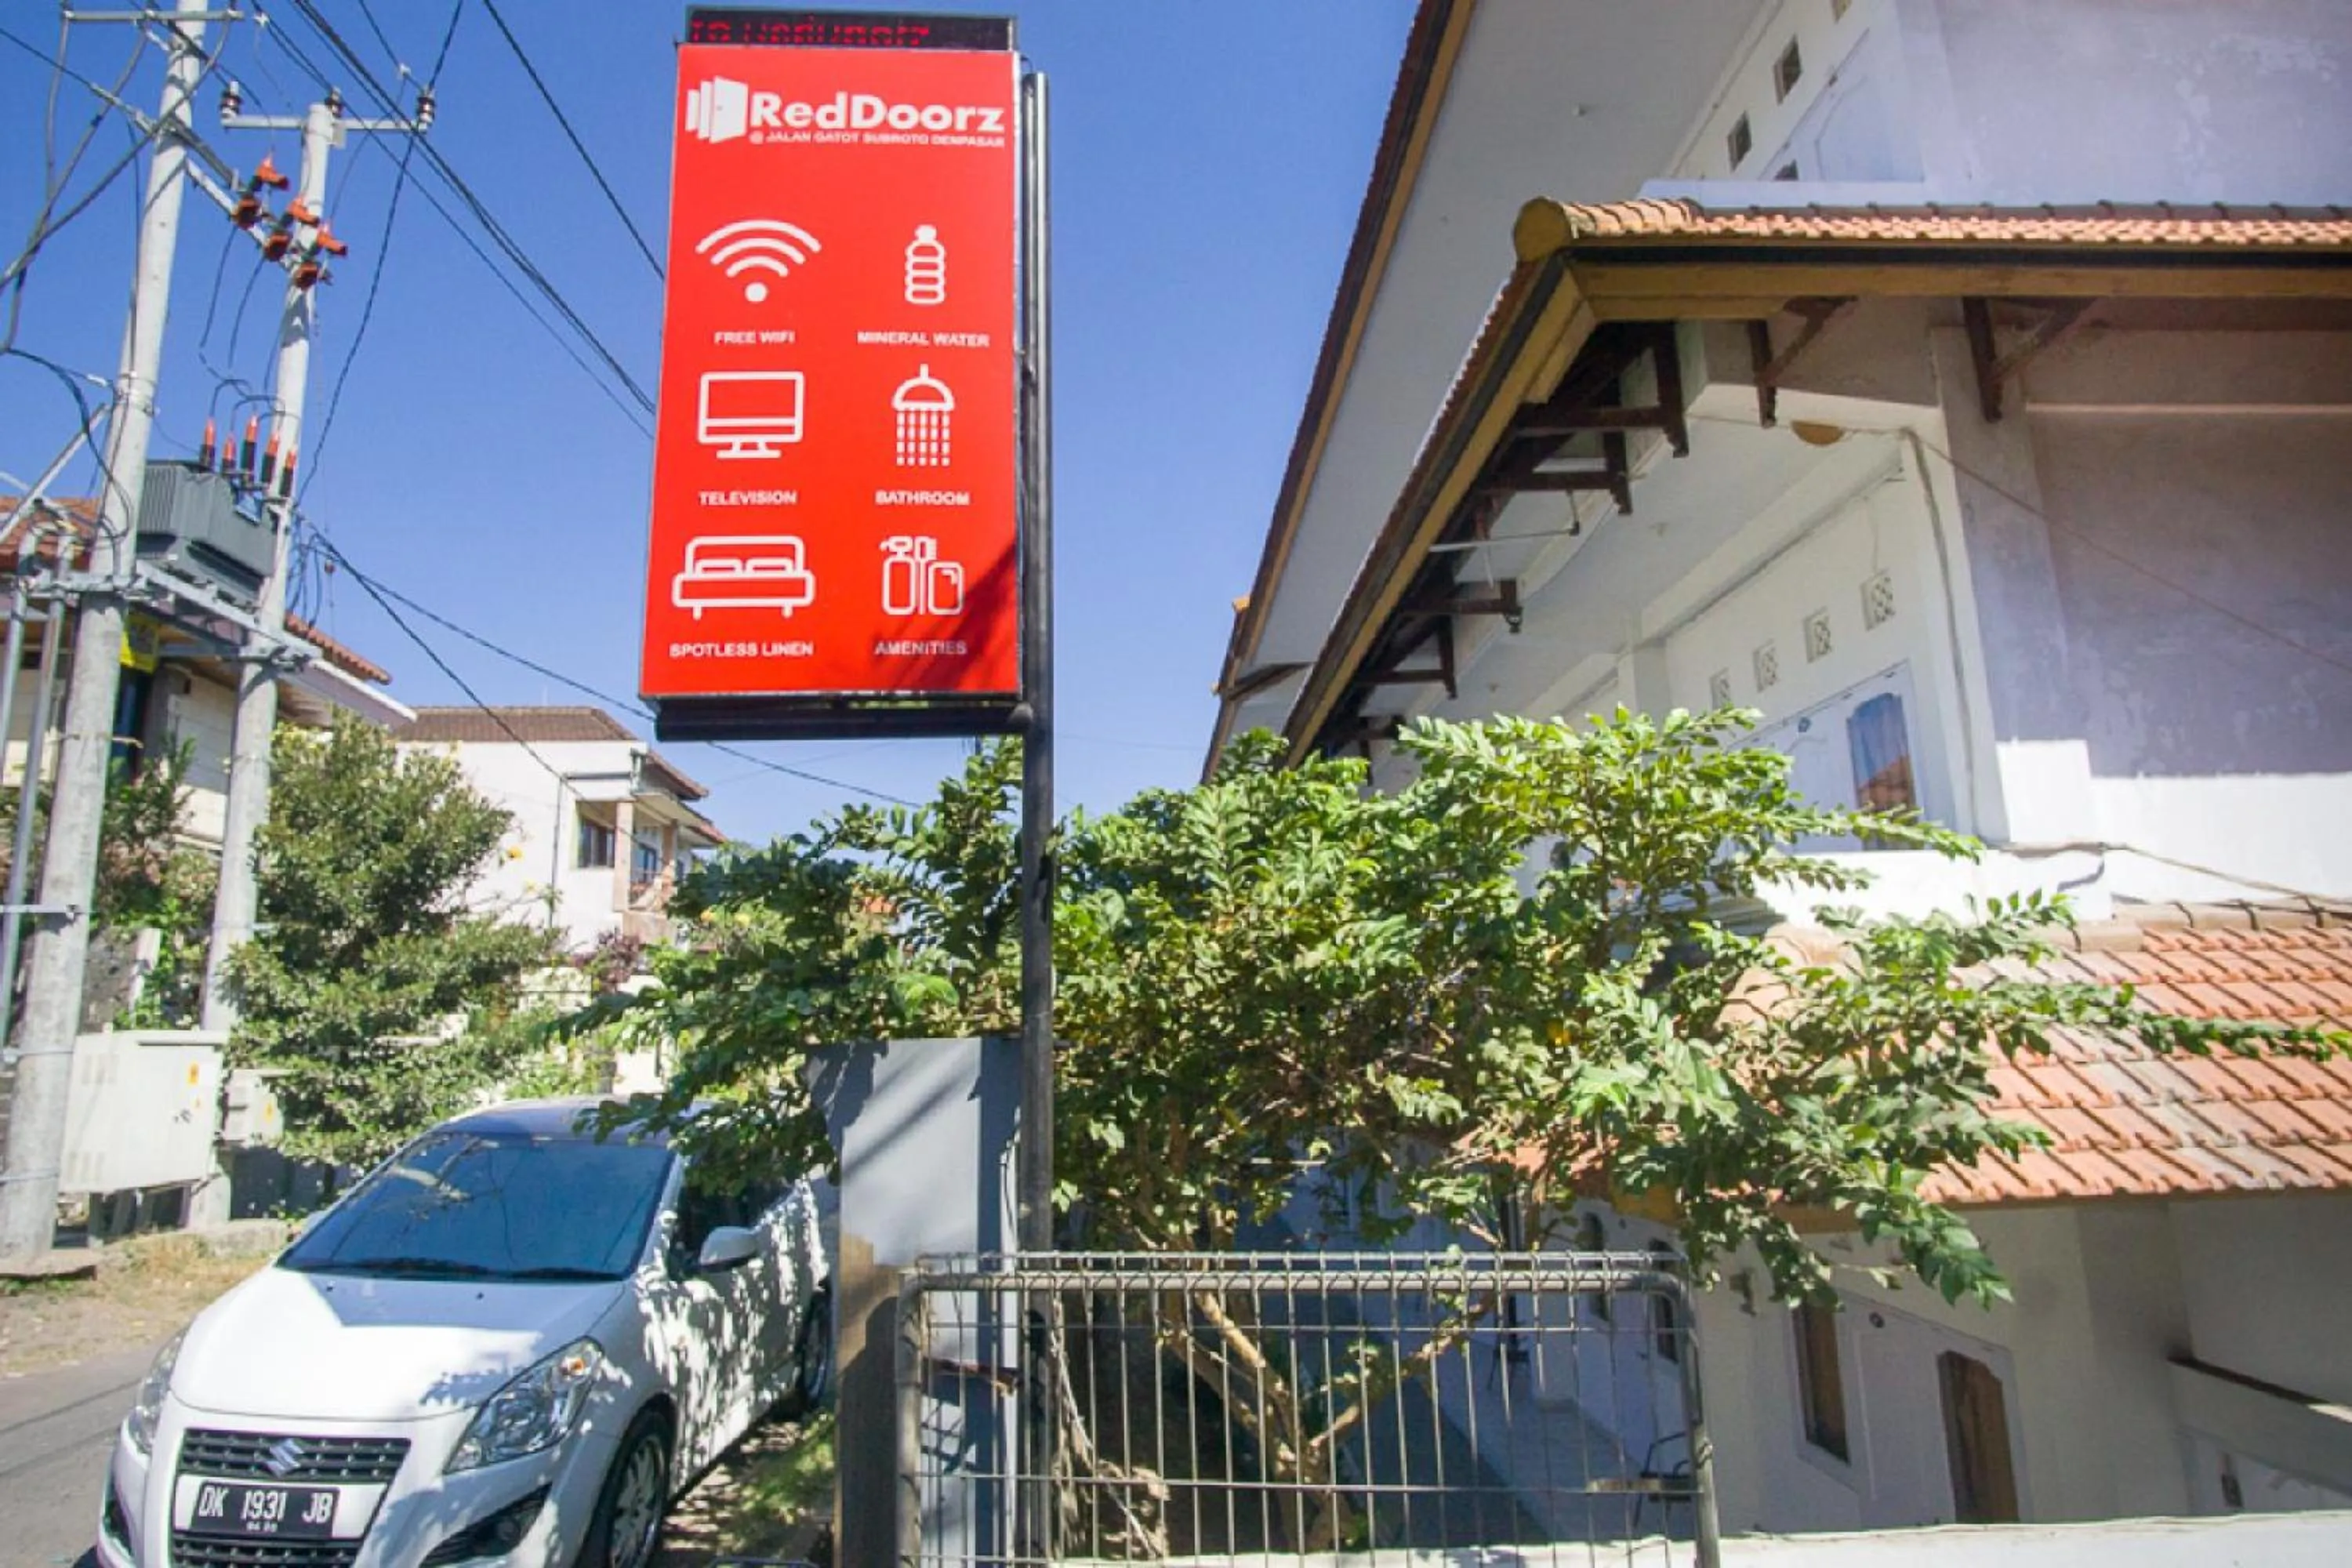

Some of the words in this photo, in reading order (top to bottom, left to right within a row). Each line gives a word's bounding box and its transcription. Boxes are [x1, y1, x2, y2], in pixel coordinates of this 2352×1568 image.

[750, 92, 1005, 132] RedDoorz
[750, 132, 764, 144] @
[766, 131, 811, 143] JALAN
[815, 132, 860, 143] GATOT
[863, 133, 930, 145] SUBROTO
[931, 136, 1005, 147] DENPASAR
[714, 331, 757, 344] FREE
[760, 331, 795, 343] WIFI
[857, 332, 929, 346] MINERAL
[933, 332, 989, 347] WATER
[699, 490, 797, 506] TELEVISION
[875, 490, 970, 506] BATHROOM
[670, 641, 758, 658] SPOTLESS
[761, 641, 814, 657] LINEN
[874, 640, 967, 655] AMENITIES
[198, 1485, 228, 1518] DK
[241, 1490, 288, 1521] 1931
[301, 1492, 334, 1524] JB
